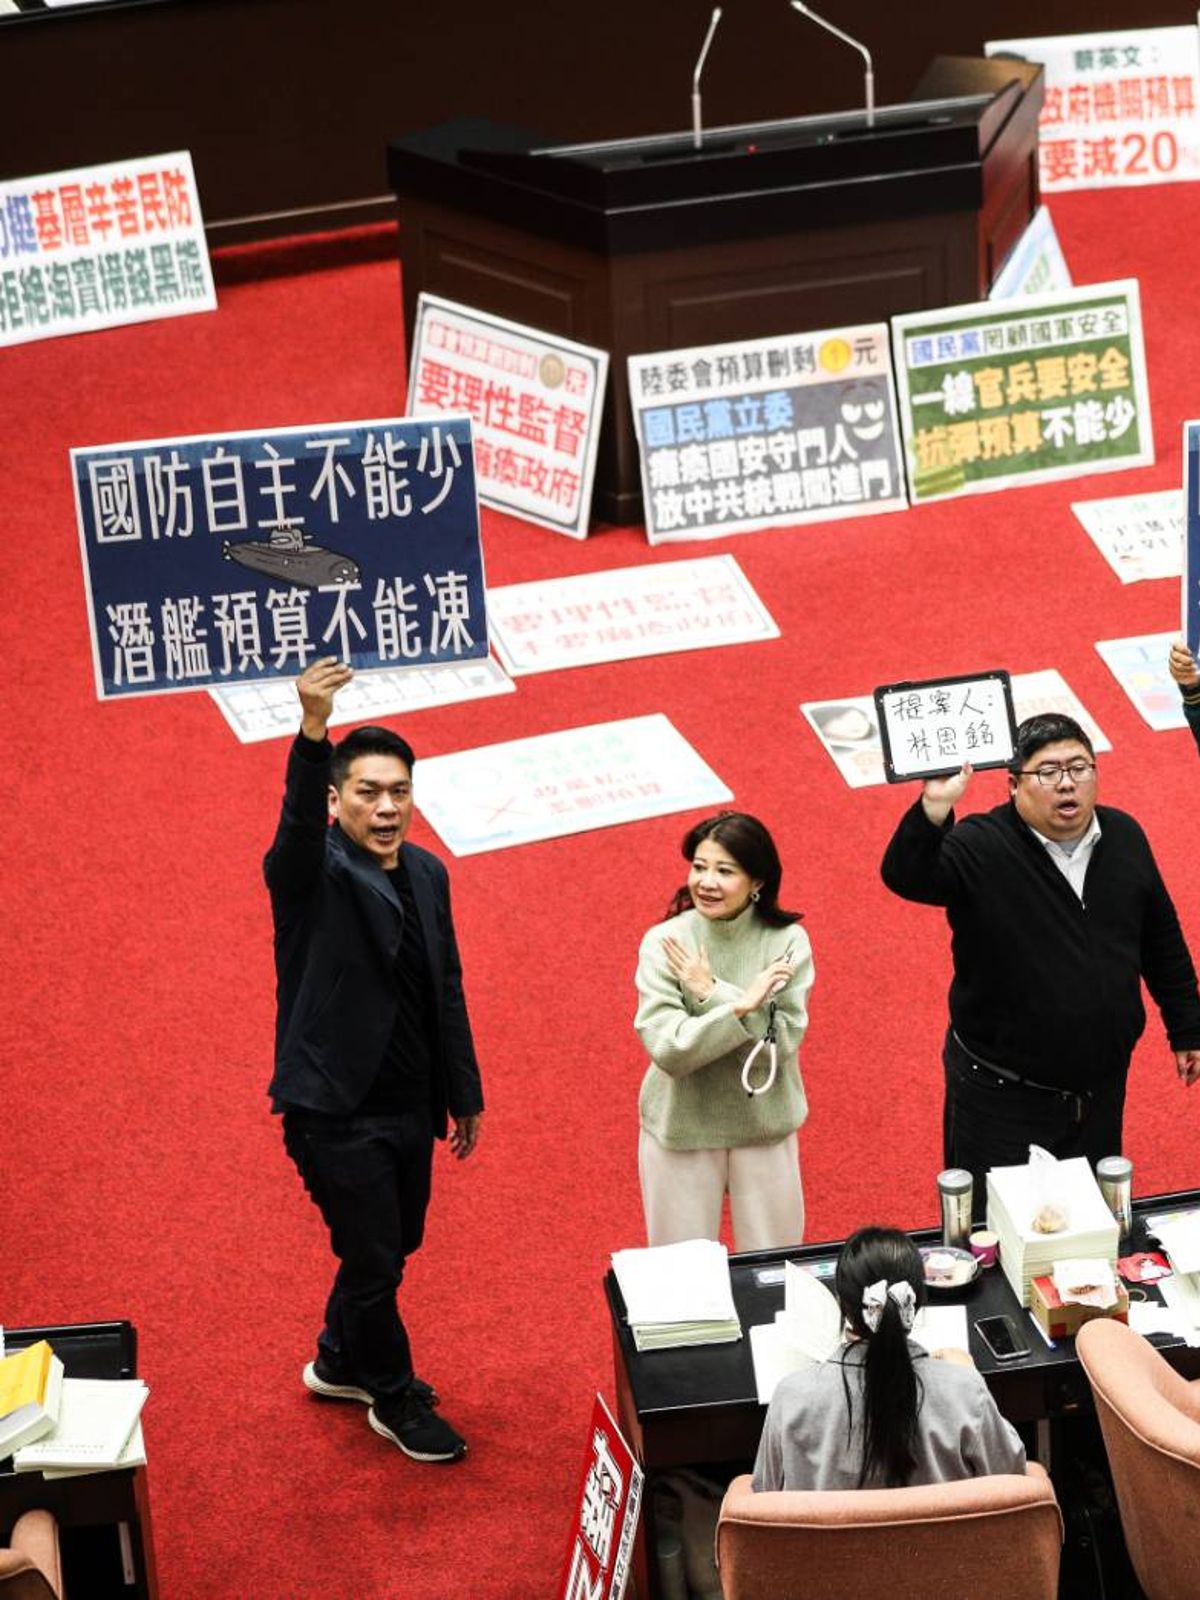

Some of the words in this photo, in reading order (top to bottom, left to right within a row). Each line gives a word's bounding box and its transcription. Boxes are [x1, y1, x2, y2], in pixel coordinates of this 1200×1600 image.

[911, 308, 1124, 365] 國民黨罔顧國軍安全
[419, 357, 588, 457] 要理性監督
[644, 390, 794, 446] 國民黨立委
[912, 348, 1131, 417] 一線官兵要安全
[649, 424, 858, 490] 癱瘓國安守門人
[915, 395, 1137, 470] 抗彈預算不能少
[88, 426, 462, 543] 國防自主不能少
[107, 571, 476, 686] 潛艦預算不能凍
